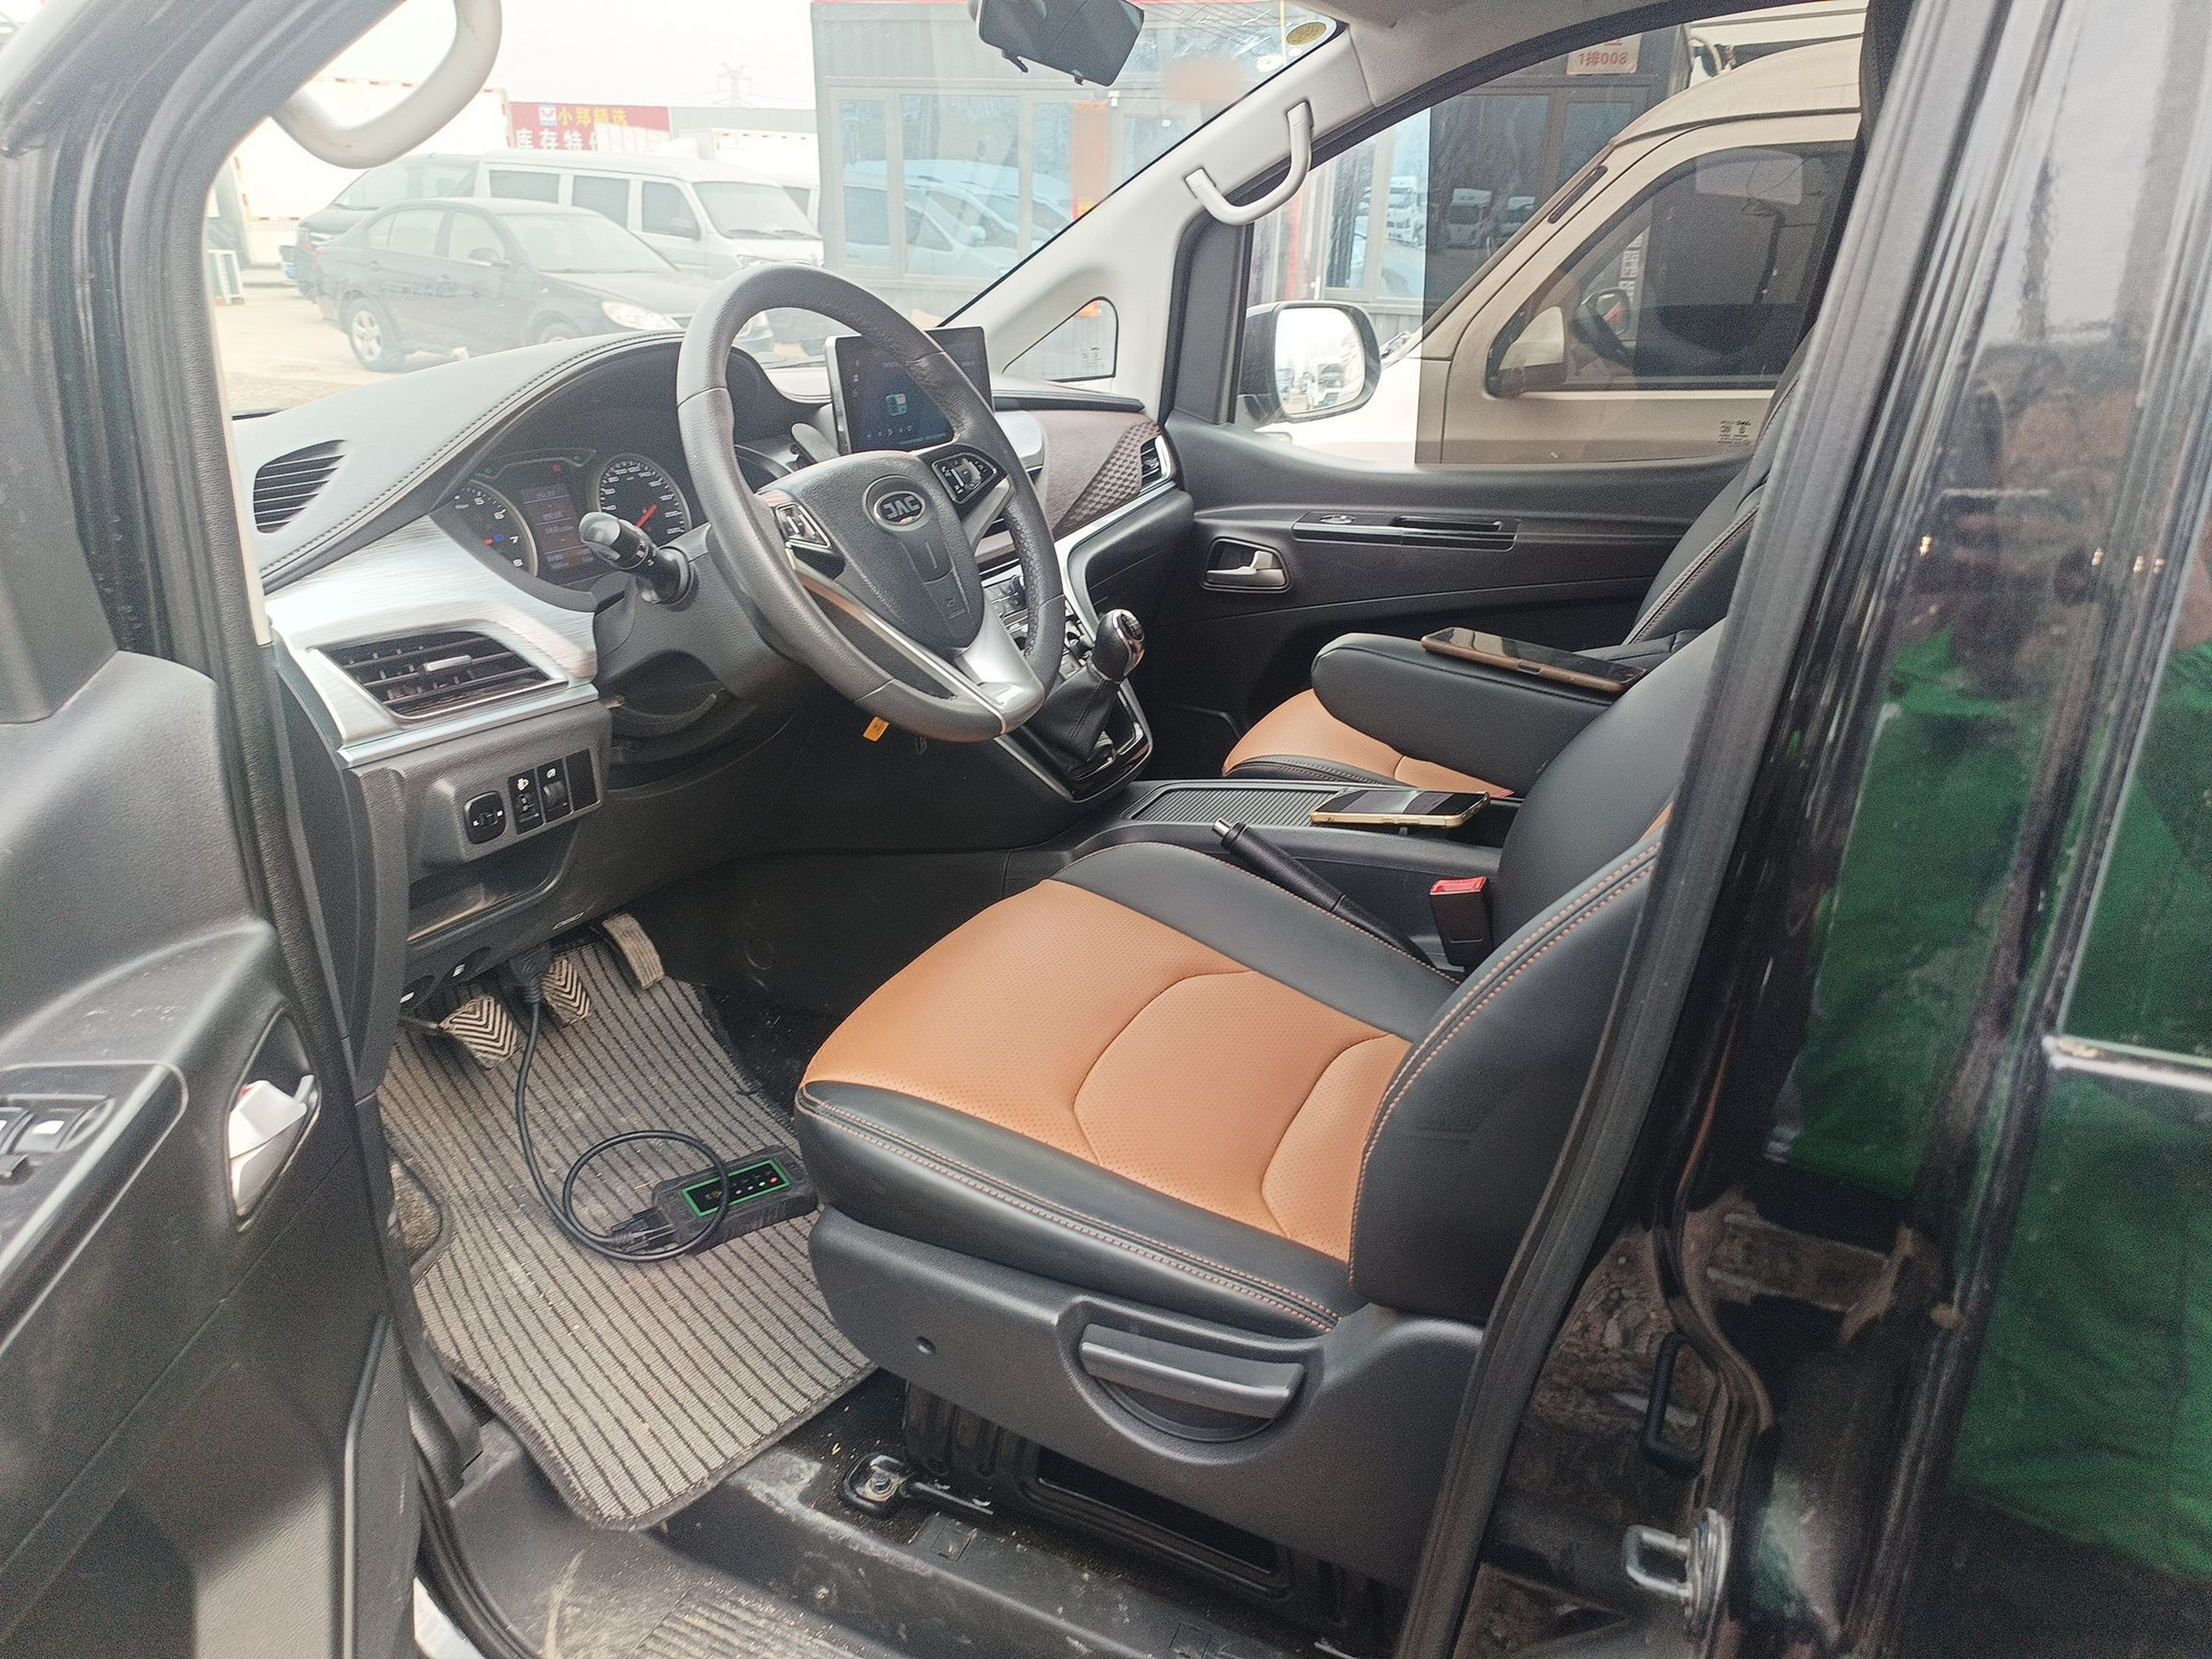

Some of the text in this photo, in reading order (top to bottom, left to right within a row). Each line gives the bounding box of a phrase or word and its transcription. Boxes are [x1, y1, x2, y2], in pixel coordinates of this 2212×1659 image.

[474, 497, 485, 505] 5
[882, 495, 921, 520] JAC
[510, 536, 519, 544] 7
[513, 559, 522, 567] 8
